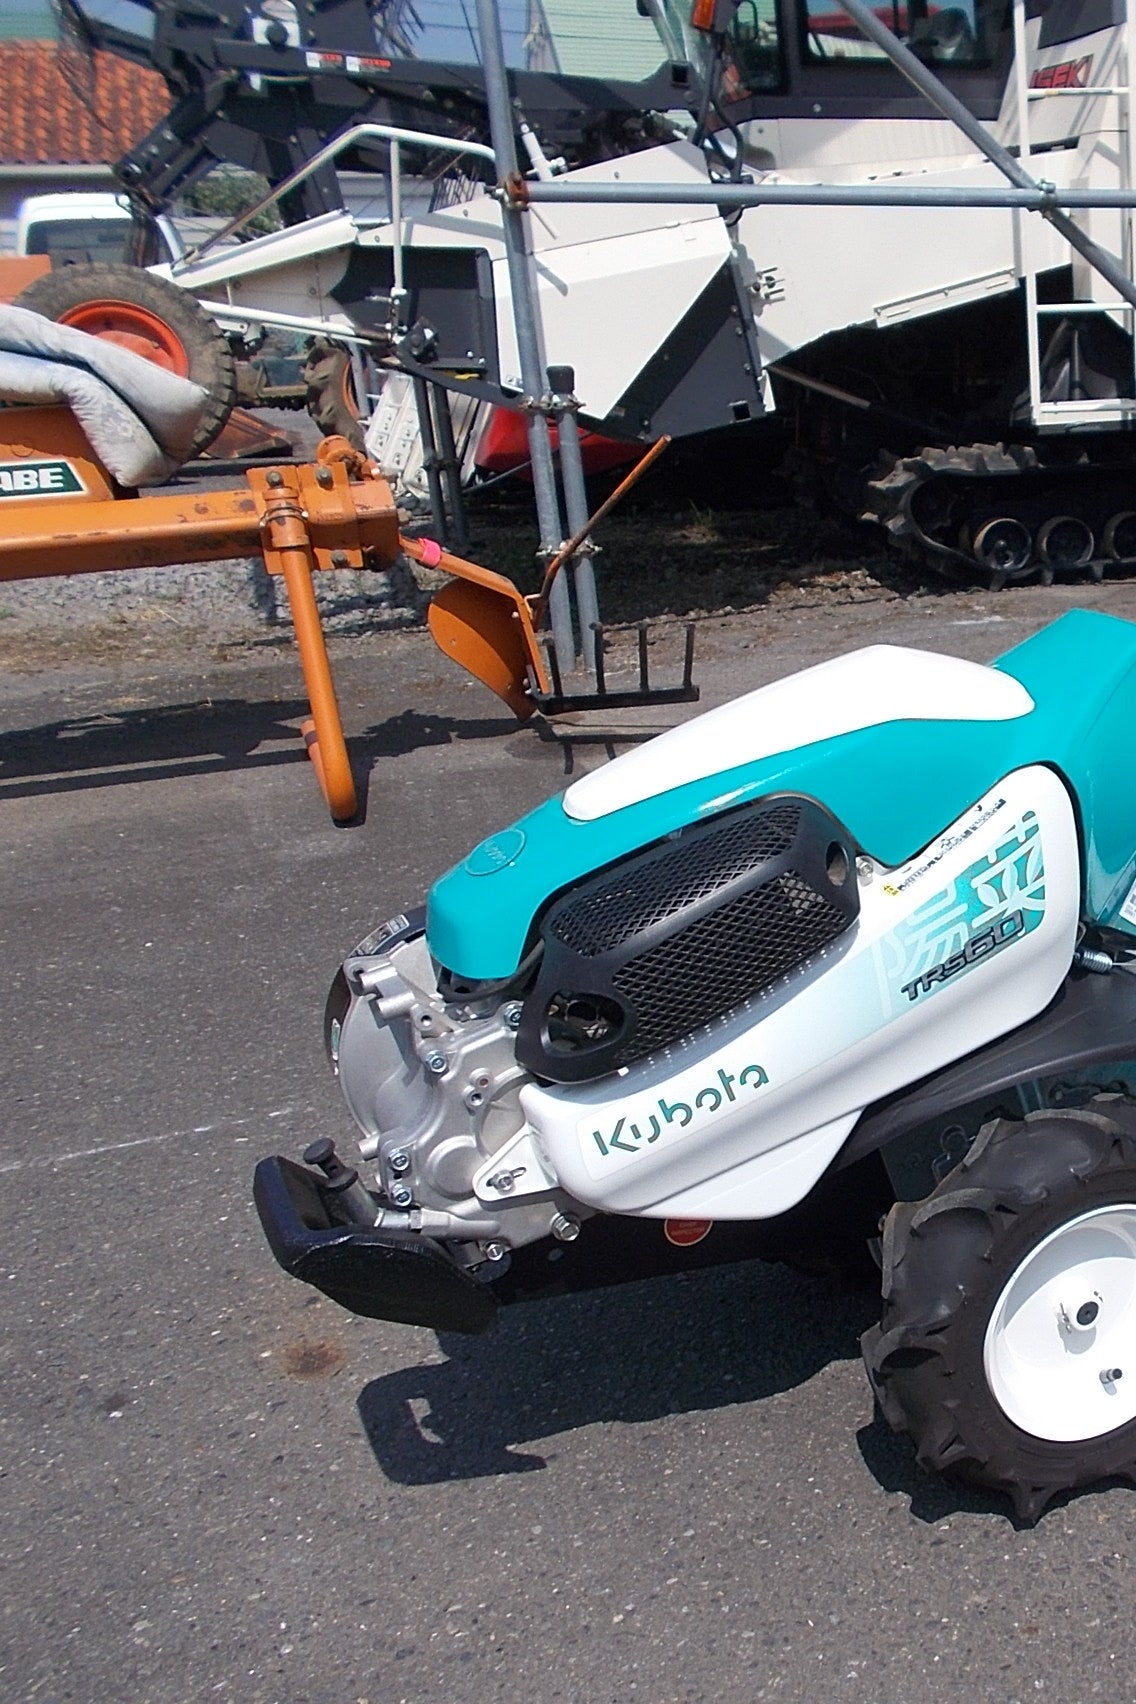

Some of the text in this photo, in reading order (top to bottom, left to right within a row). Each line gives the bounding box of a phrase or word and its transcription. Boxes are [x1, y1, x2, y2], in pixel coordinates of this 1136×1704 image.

[1029, 53, 1095, 89] ISEKI
[900, 908, 1025, 1001] TRS60
[592, 1064, 770, 1156] Kubota
